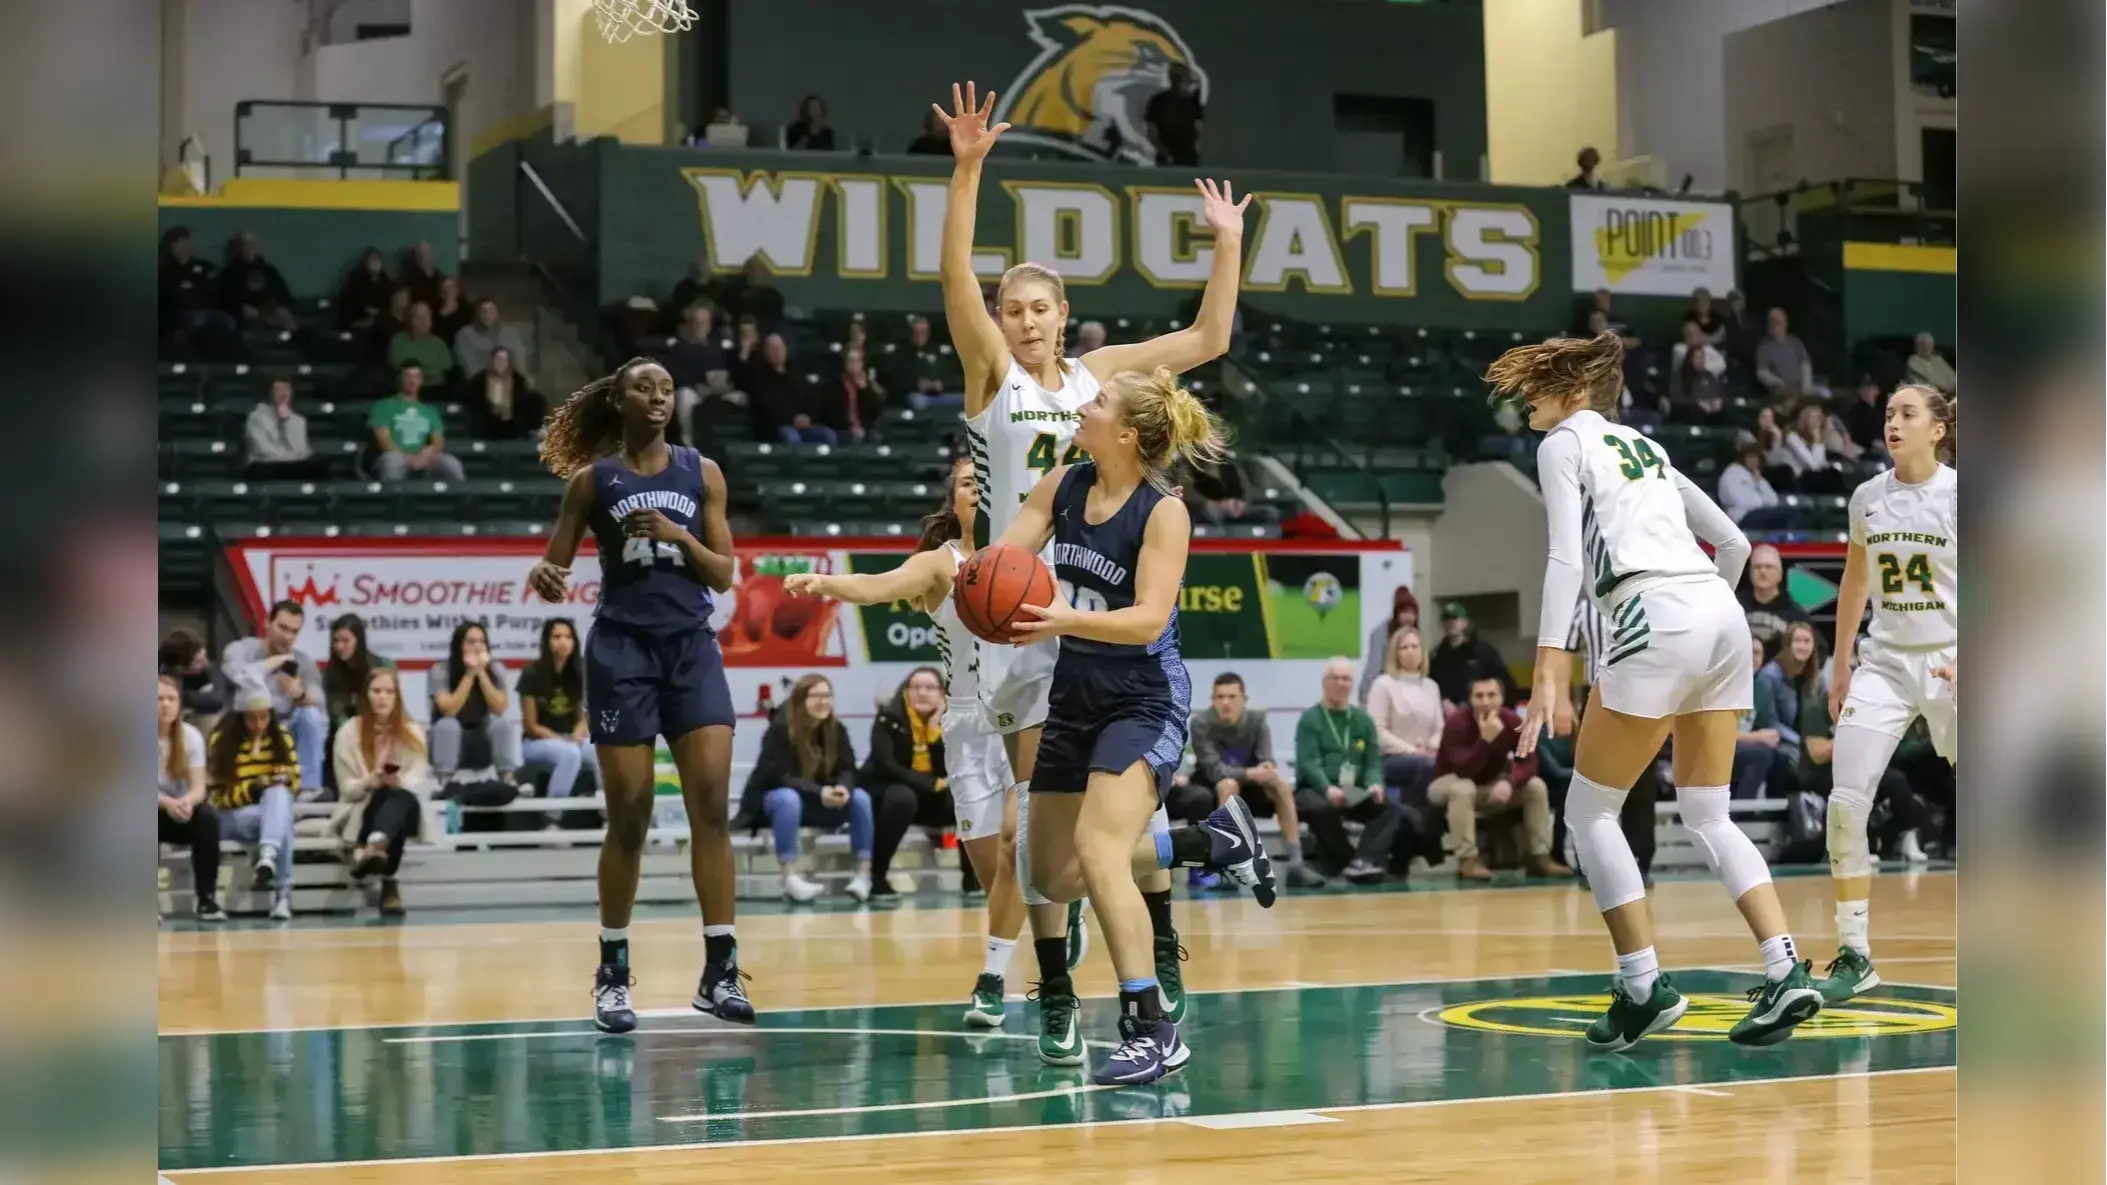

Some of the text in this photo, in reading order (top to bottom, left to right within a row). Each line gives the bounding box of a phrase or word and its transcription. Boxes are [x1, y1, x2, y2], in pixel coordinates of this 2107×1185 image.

[681, 167, 1541, 300] WILDCATS
[1606, 208, 1681, 259] POINT
[1603, 434, 1668, 481] 34
[608, 490, 697, 523] NORTHWOOD
[1866, 532, 1949, 548] NORTHERN
[1055, 543, 1128, 586] ORTHWOOD
[1877, 552, 1935, 594] 24
[349, 573, 599, 606] SMOOTHIE KNG
[1881, 601, 1946, 612] MICHIGAN
[496, 613, 573, 633] Purp
